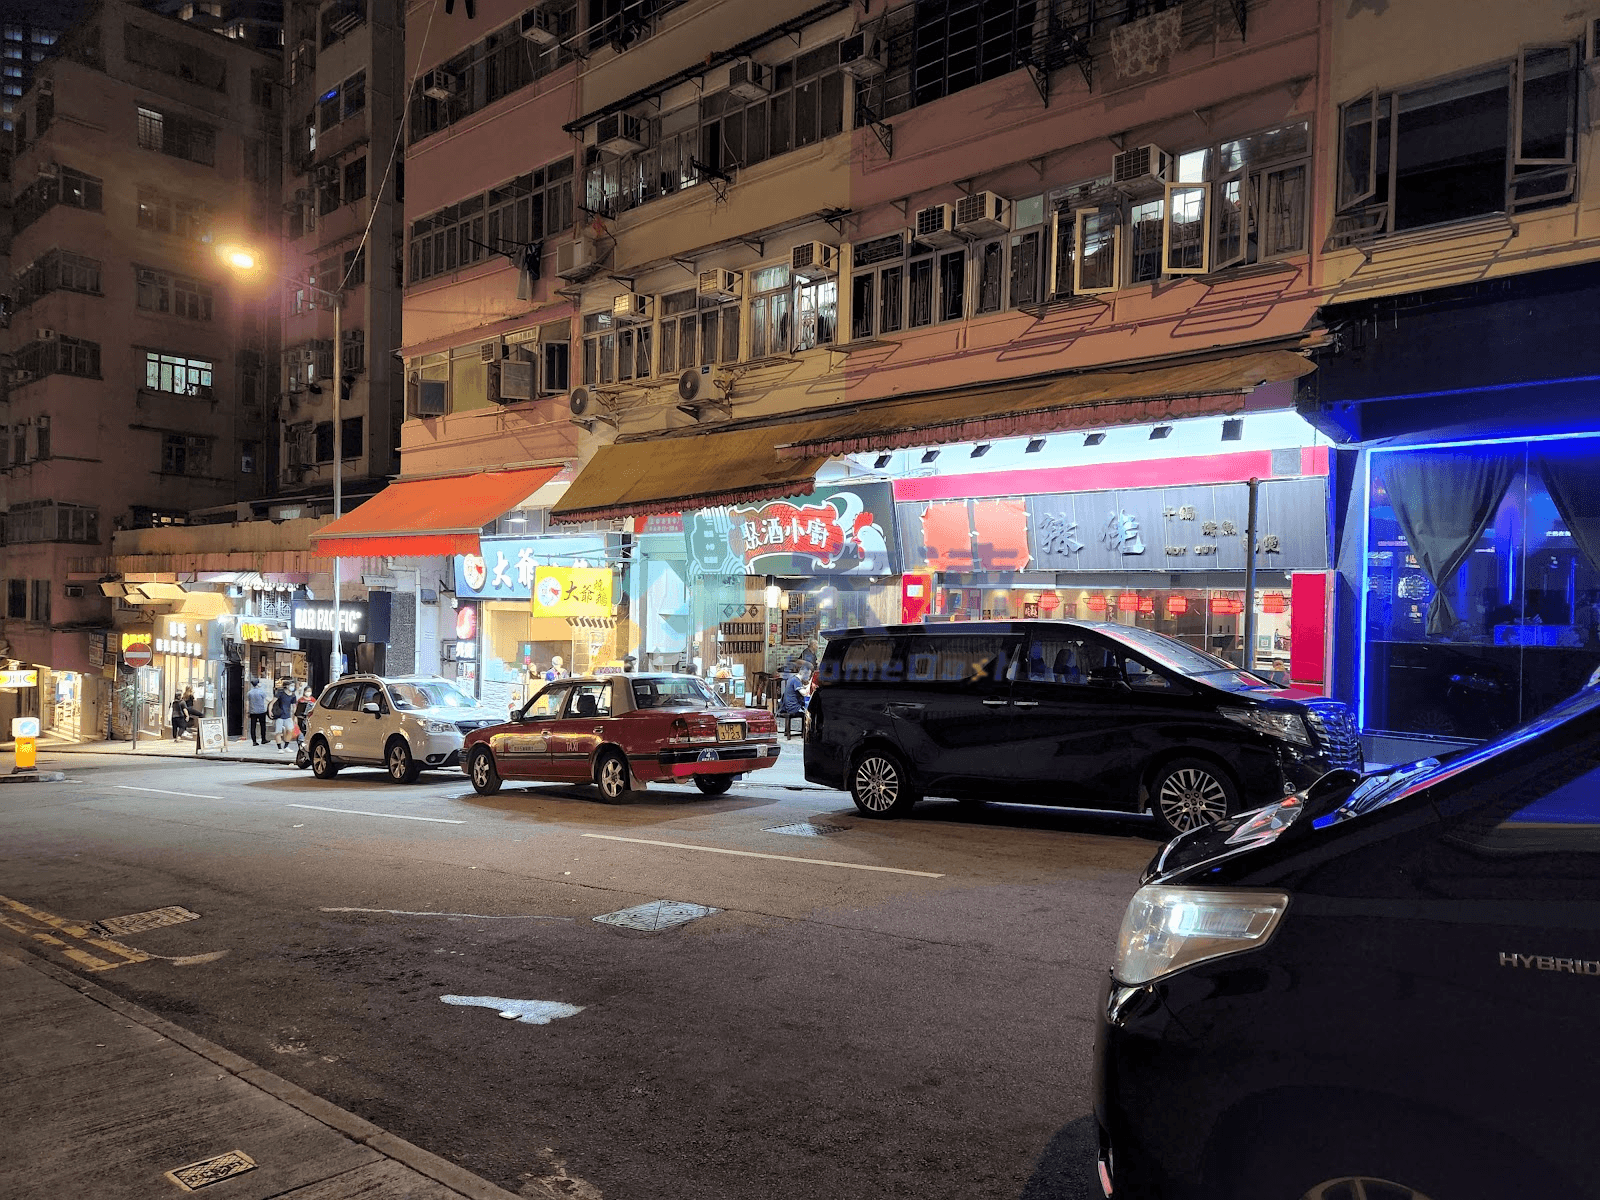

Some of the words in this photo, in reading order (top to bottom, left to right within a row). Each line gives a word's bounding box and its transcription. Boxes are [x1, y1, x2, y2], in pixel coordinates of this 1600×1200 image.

[295, 608, 316, 630] BAR
[317, 609, 358, 633] PACFIC
[724, 724, 735, 732] UR
[720, 732, 741, 740] 3723
[565, 741, 579, 752] TAXI
